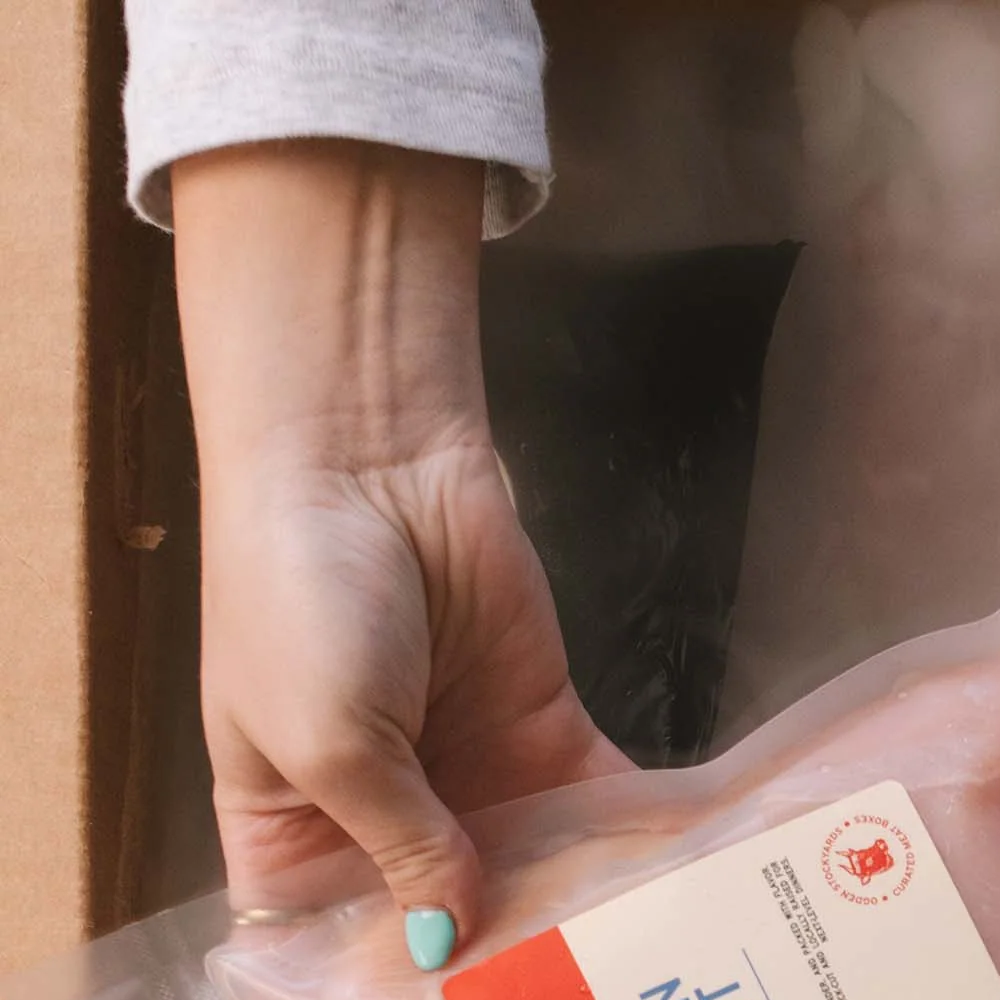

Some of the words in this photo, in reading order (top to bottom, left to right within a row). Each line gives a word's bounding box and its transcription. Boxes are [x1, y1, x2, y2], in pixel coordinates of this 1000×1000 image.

[853, 815, 889, 828] BOXES
[890, 826, 911, 850] MEAT
[768, 859, 784, 878] FOR
[822, 827, 843, 891] STOCKYARDS
[893, 852, 915, 896] CURATED
[778, 879, 800, 911] RAISED
[841, 890, 878, 905] OGDEN
[777, 899, 793, 920] WITH
[798, 894, 829, 943] NEXT-LEVEL
[788, 921, 811, 955] PACKED
[795, 911, 820, 949] LOCALLY
[806, 956, 822, 977] AND
[814, 950, 830, 970] AND
